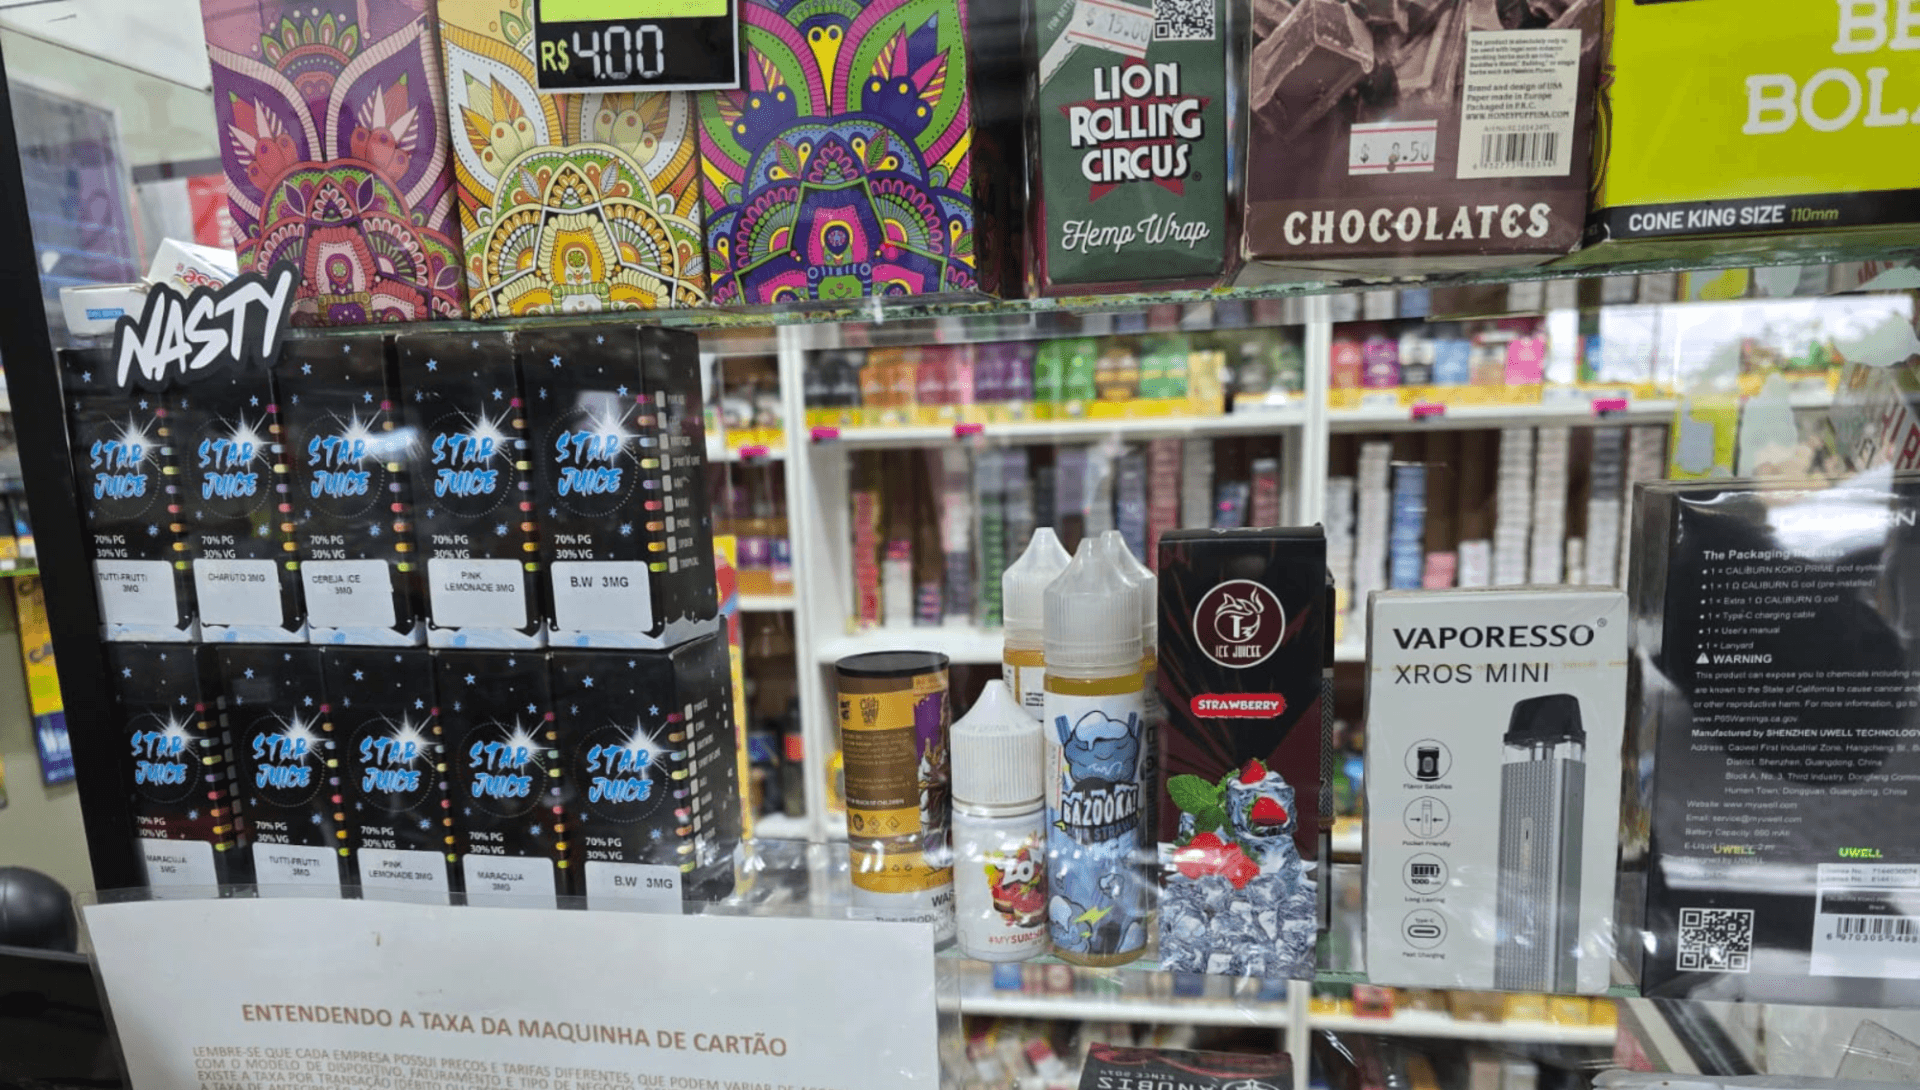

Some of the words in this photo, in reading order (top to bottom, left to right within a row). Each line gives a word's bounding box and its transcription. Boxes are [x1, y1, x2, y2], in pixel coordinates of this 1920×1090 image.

[1108, 13, 1150, 43] 15.00
[540, 39, 570, 74] R$
[572, 24, 665, 79] 4.00
[1094, 62, 1178, 100] LION
[1509, 83, 1536, 92] design
[1547, 82, 1563, 90] USA
[1466, 94, 1489, 102] Paper
[1523, 93, 1553, 101] Europe
[1741, 66, 1920, 135] BOL
[1466, 102, 1504, 112] Packaged
[1069, 99, 1202, 147] ROLLING
[1081, 144, 1189, 182] CIRCUS
[1283, 202, 1552, 246] CHOCOLATES
[1628, 210, 1684, 232] CONE
[1687, 208, 1737, 229] KING
[1739, 204, 1786, 225] SIZE
[1790, 207, 1840, 223] 110mm
[1061, 219, 1136, 254] Hemp
[1136, 212, 1210, 249] Wrap
[116, 269, 293, 388] NASTY
[90, 438, 145, 470] STAR
[198, 437, 254, 470] STAR
[307, 434, 367, 470] STAR
[431, 433, 494, 466] STAR
[555, 431, 620, 465] STAR
[93, 472, 148, 500] JUICE
[202, 471, 258, 500] JUICE
[311, 470, 371, 498] JUICE
[434, 467, 499, 498] JUICE
[558, 466, 624, 498] JUICE
[94, 535, 111, 546] 70%
[112, 535, 126, 546] PG
[201, 535, 217, 546] 70%
[218, 535, 234, 546] PG
[310, 535, 327, 546] 70%
[328, 535, 344, 546] PG
[431, 534, 452, 545] 70%
[453, 534, 469, 545] PG
[554, 534, 575, 545] 70%
[576, 534, 592, 545] PG
[114, 549, 128, 559] VG
[203, 549, 219, 560] 30%
[220, 549, 236, 560] VG
[311, 549, 328, 560] 30%
[329, 549, 346, 560] VG
[433, 549, 453, 560] 30%
[455, 549, 470, 560] VG
[556, 549, 577, 560] 30%
[578, 549, 593, 560] VG
[1702, 551, 1725, 560] The
[1728, 550, 1790, 561] Packaging
[208, 573, 247, 583] CHARUTO
[1725, 566, 1773, 575] CALIBURN
[1774, 565, 1803, 573] KOKO
[1804, 565, 1834, 573] PRIME
[312, 574, 344, 584] CEREJA
[346, 574, 361, 584] ICE
[570, 576, 593, 588] B.W
[602, 577, 629, 588] 3MG
[445, 582, 494, 592] LEMONADE
[495, 583, 515, 593] 3MG
[1393, 624, 1595, 650] VAPORESSO
[1215, 645, 1229, 658] ICE
[1713, 654, 1773, 664] WARNING
[1394, 663, 1473, 685] XROS
[1485, 662, 1550, 683] MINI
[1198, 699, 1279, 711] STRAWBERRY
[1691, 729, 1751, 738] Manufactured
[1752, 729, 1765, 739] by
[1766, 729, 1818, 738] SHENZHEN
[1819, 729, 1853, 738] UWELL
[131, 730, 185, 758] STAR
[252, 732, 311, 762] STAR
[359, 735, 417, 765] STAR
[469, 740, 531, 769] STAR
[586, 744, 652, 773] STAR
[135, 760, 188, 786] JUICE
[256, 764, 312, 790] JUICE
[362, 767, 421, 793] JUICE
[471, 772, 533, 798] JUICE
[589, 776, 655, 804] JUICE
[1063, 790, 1136, 827] BAZOOKA!
[255, 821, 272, 832] 70%
[273, 821, 288, 832] PG
[360, 826, 378, 837] 70%
[379, 826, 394, 837] PG
[275, 834, 290, 845] VG
[380, 838, 396, 849] VG
[469, 831, 487, 842] 70%
[488, 831, 504, 842] PG
[585, 837, 606, 848] 70%
[607, 837, 622, 848] PG
[489, 844, 506, 855] VG
[586, 850, 607, 861] 30%
[607, 850, 623, 861] VG
[1838, 847, 1884, 858] UWELL
[477, 871, 524, 882] MARACUJA
[614, 875, 637, 887] B.W
[646, 877, 673, 890] 3MG
[241, 1003, 393, 1027] ENTENDENDO
[399, 1010, 415, 1028] A
[418, 1011, 475, 1034] TAXA
[481, 1017, 513, 1036] DA
[518, 1019, 650, 1047] MAQUINHA
[656, 1029, 687, 1050] DE
[693, 1032, 787, 1057] CARTÃO
[264, 1047, 292, 1060] QUE
[295, 1048, 330, 1060] CADA
[333, 1050, 390, 1063] EMPRESA
